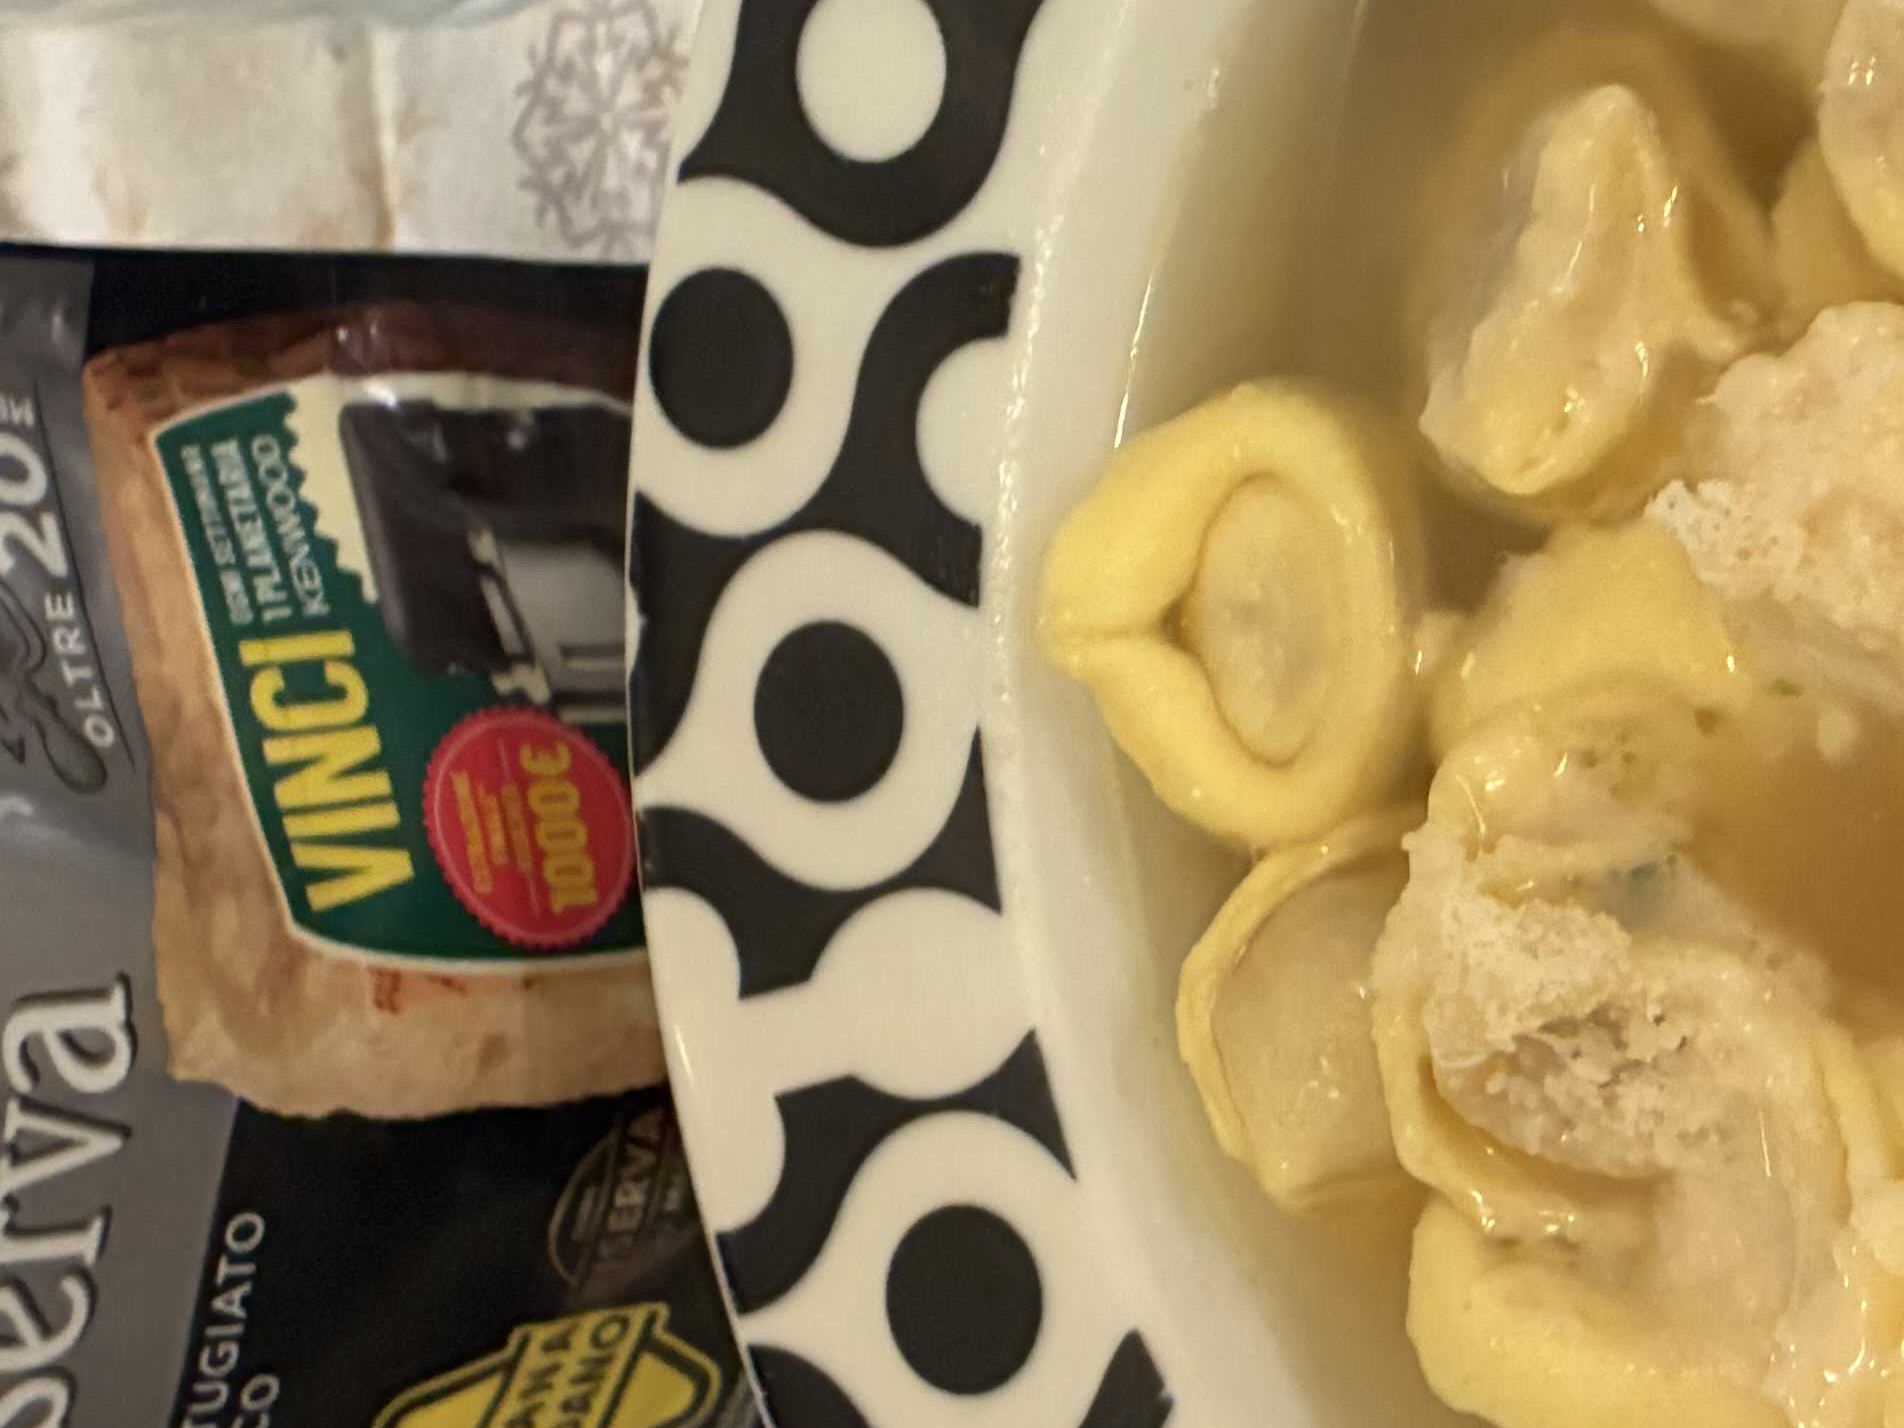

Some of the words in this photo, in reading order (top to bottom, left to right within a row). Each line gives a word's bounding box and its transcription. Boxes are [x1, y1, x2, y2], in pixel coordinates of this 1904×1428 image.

[251, 434, 331, 617] KENWOOD
[44, 590, 115, 749] OLTRE
[239, 630, 415, 911] VINCI
[519, 739, 599, 914] 1000€
